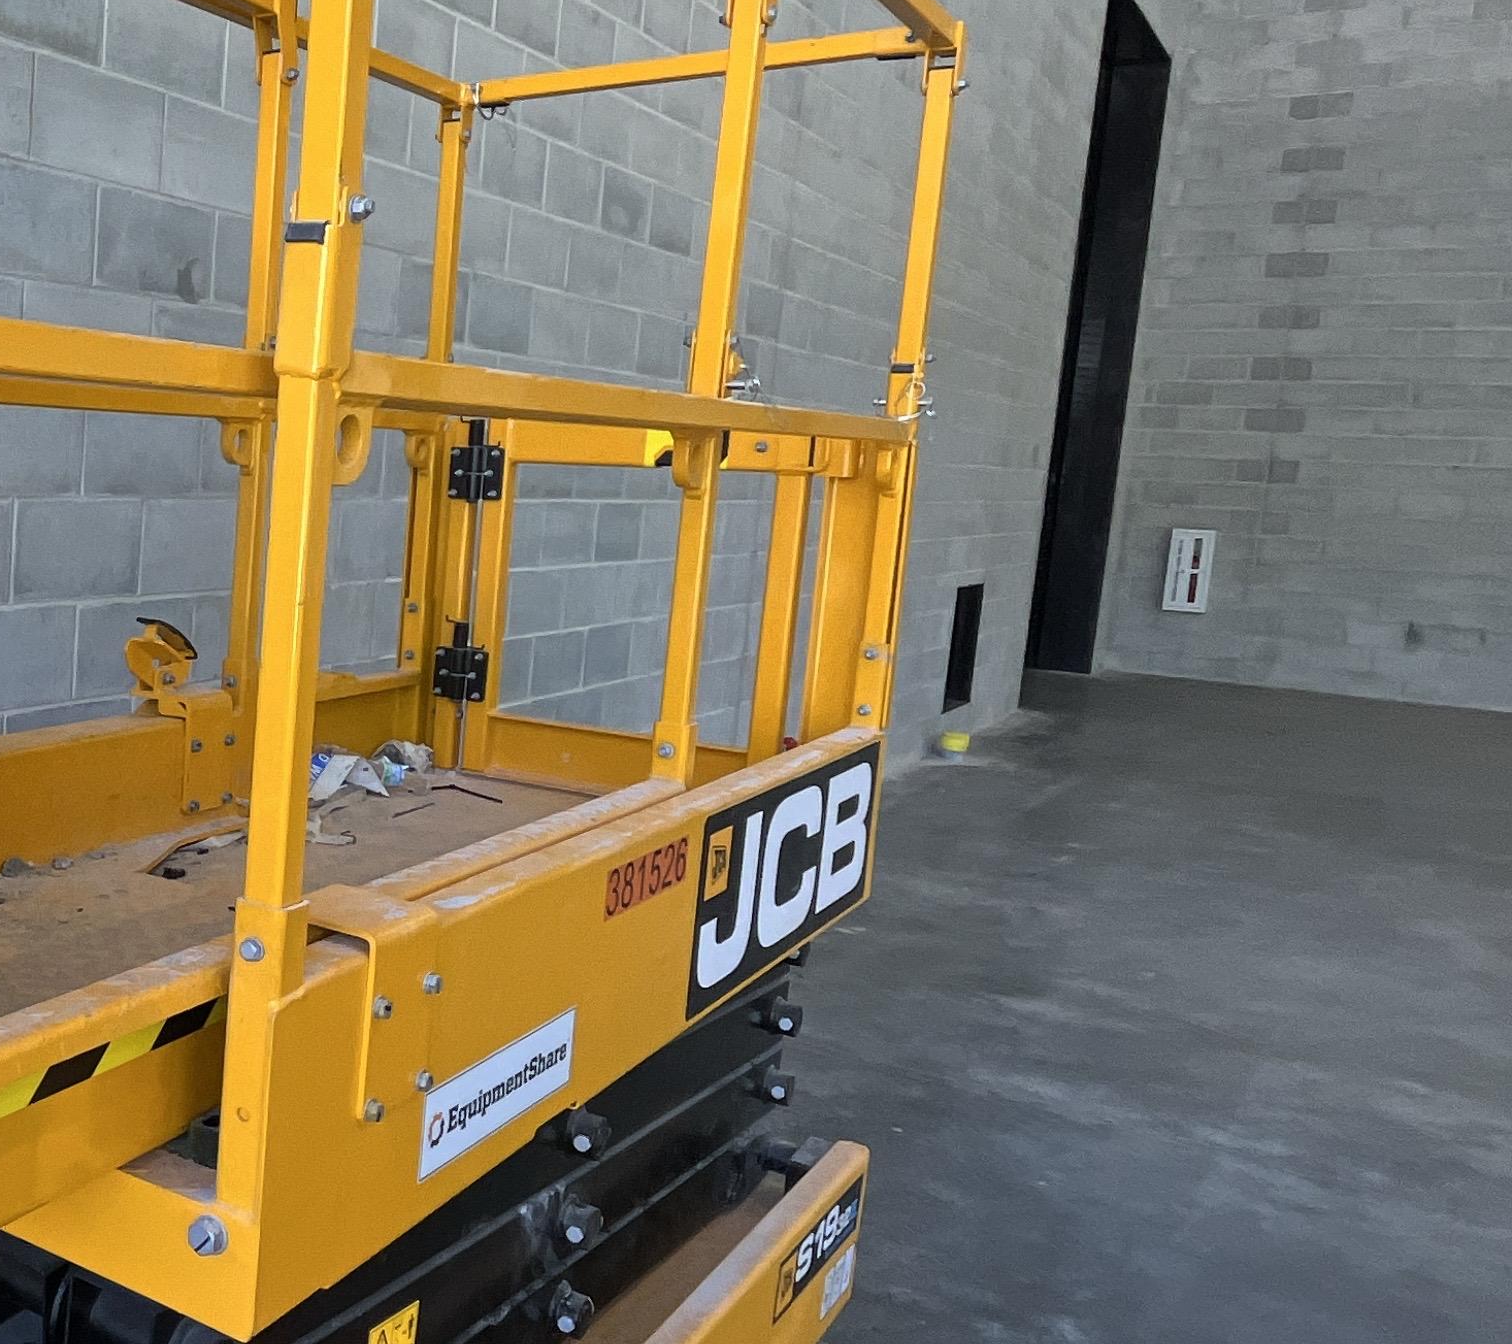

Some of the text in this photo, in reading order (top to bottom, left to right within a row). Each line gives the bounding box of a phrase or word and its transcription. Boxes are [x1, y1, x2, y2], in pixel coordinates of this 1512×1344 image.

[605, 837, 688, 917] 381526
[696, 761, 873, 989] JCB
[447, 1042, 568, 1134] EquipmentShare
